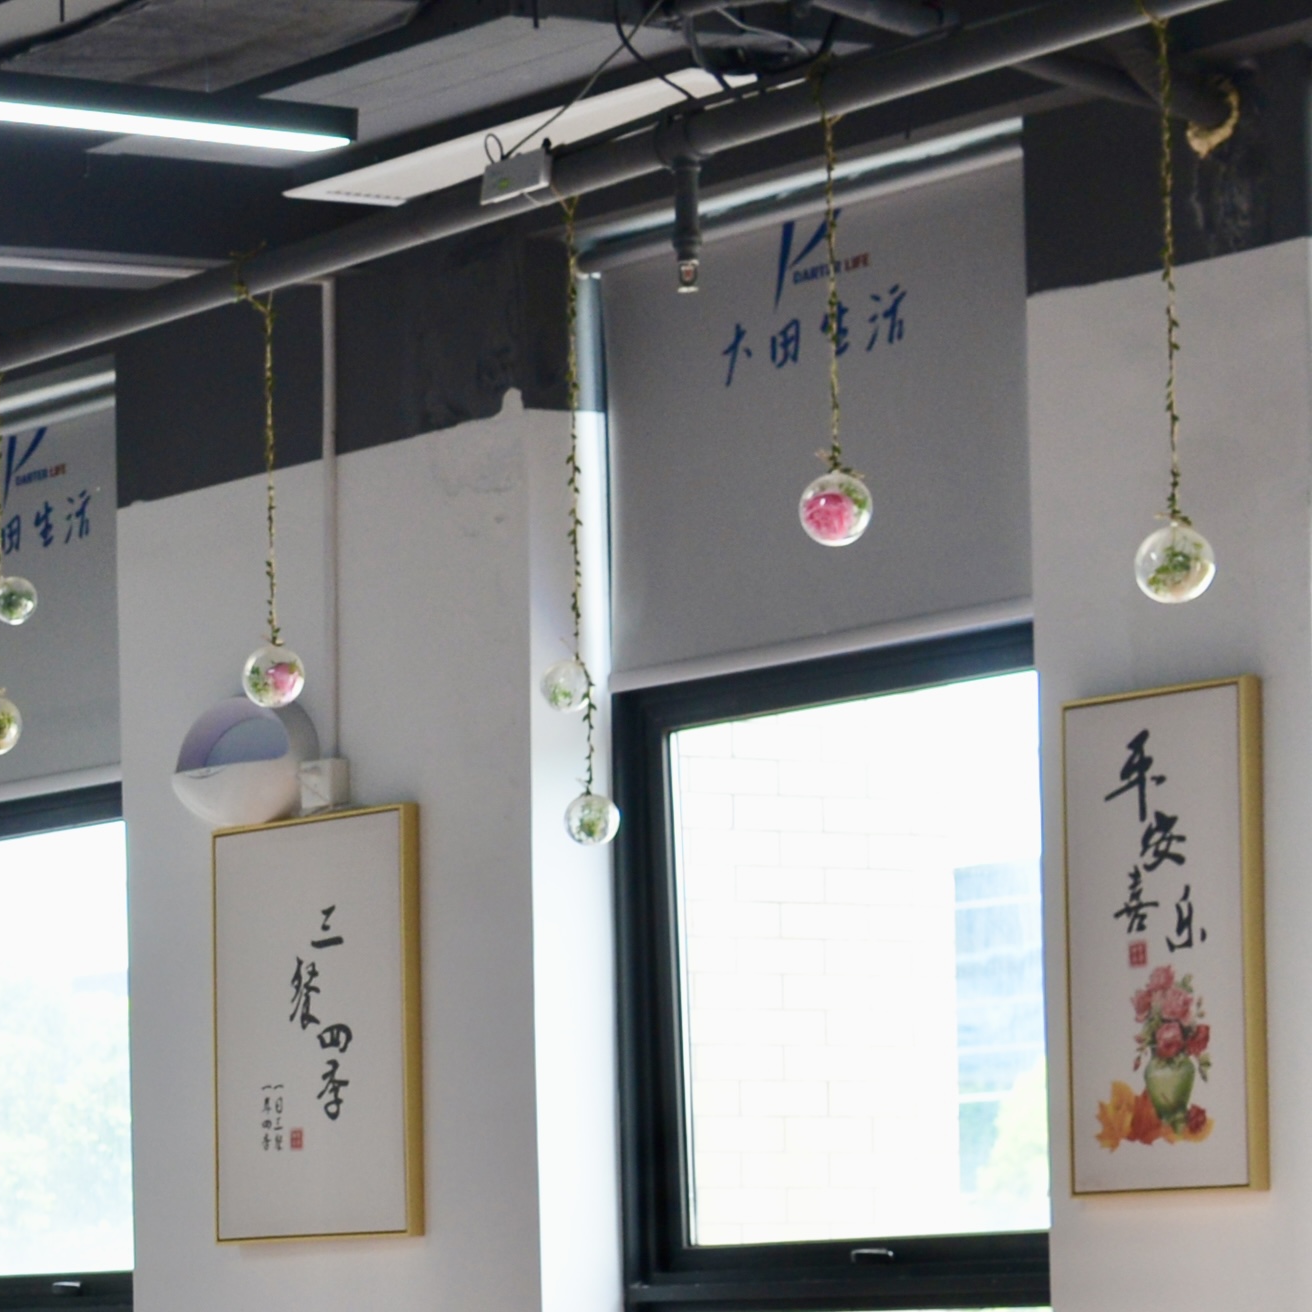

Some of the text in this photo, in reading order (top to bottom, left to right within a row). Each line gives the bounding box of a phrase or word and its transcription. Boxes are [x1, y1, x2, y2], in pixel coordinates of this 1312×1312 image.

[844, 253, 869, 273] LIFE
[289, 905, 353, 1121] 三餐四季
